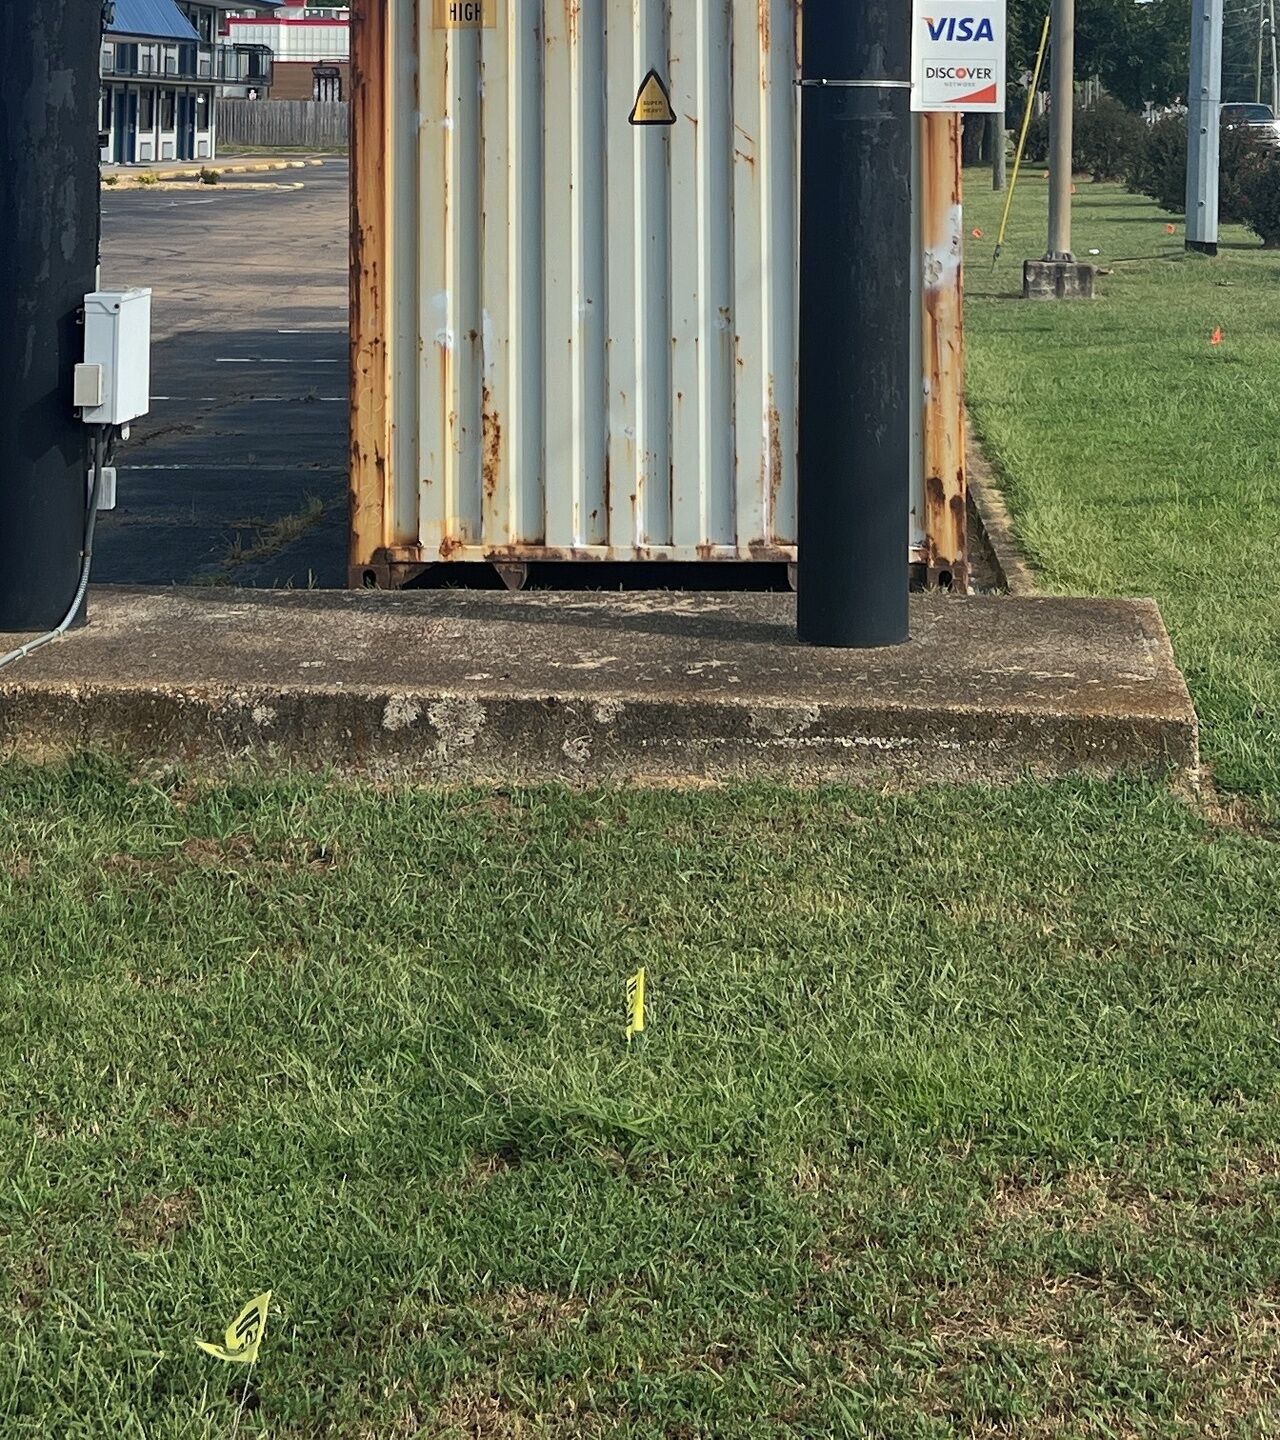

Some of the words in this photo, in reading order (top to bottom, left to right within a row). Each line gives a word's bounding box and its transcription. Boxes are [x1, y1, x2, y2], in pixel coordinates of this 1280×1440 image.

[449, 3, 482, 21] HIGH
[922, 17, 994, 42] VISA
[926, 67, 992, 79] DISCOVER
